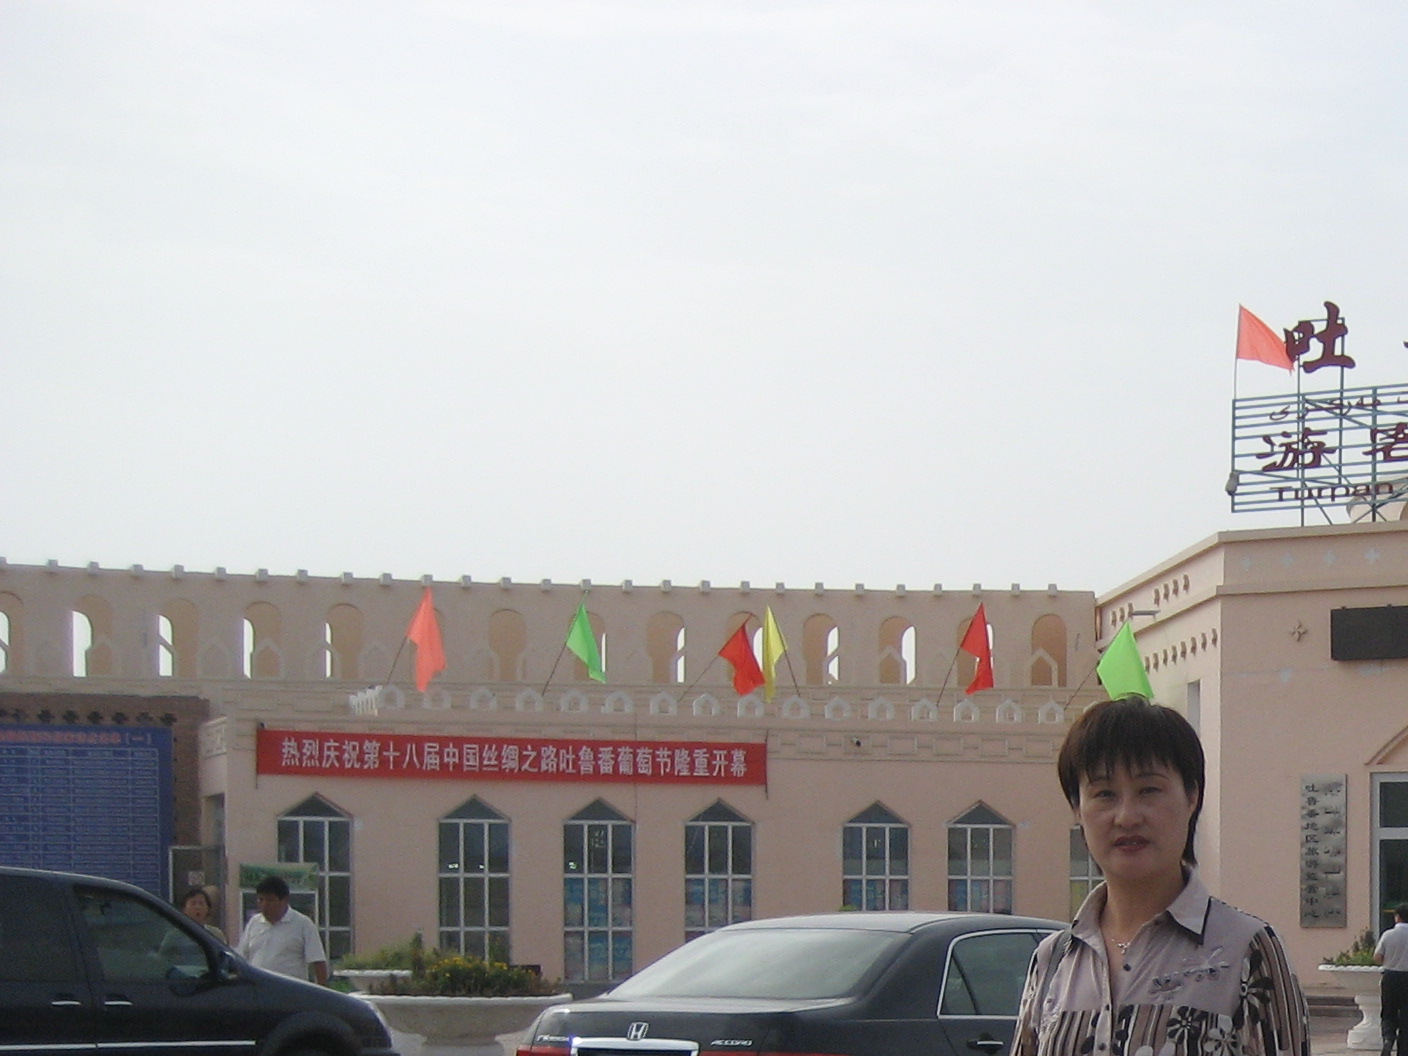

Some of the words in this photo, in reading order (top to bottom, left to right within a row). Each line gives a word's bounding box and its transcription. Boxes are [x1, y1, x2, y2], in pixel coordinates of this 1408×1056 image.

[281, 736, 748, 778] 热烈庆祝第十八届中国丝绸之路吐鲁番葡萄节隆重开幕
